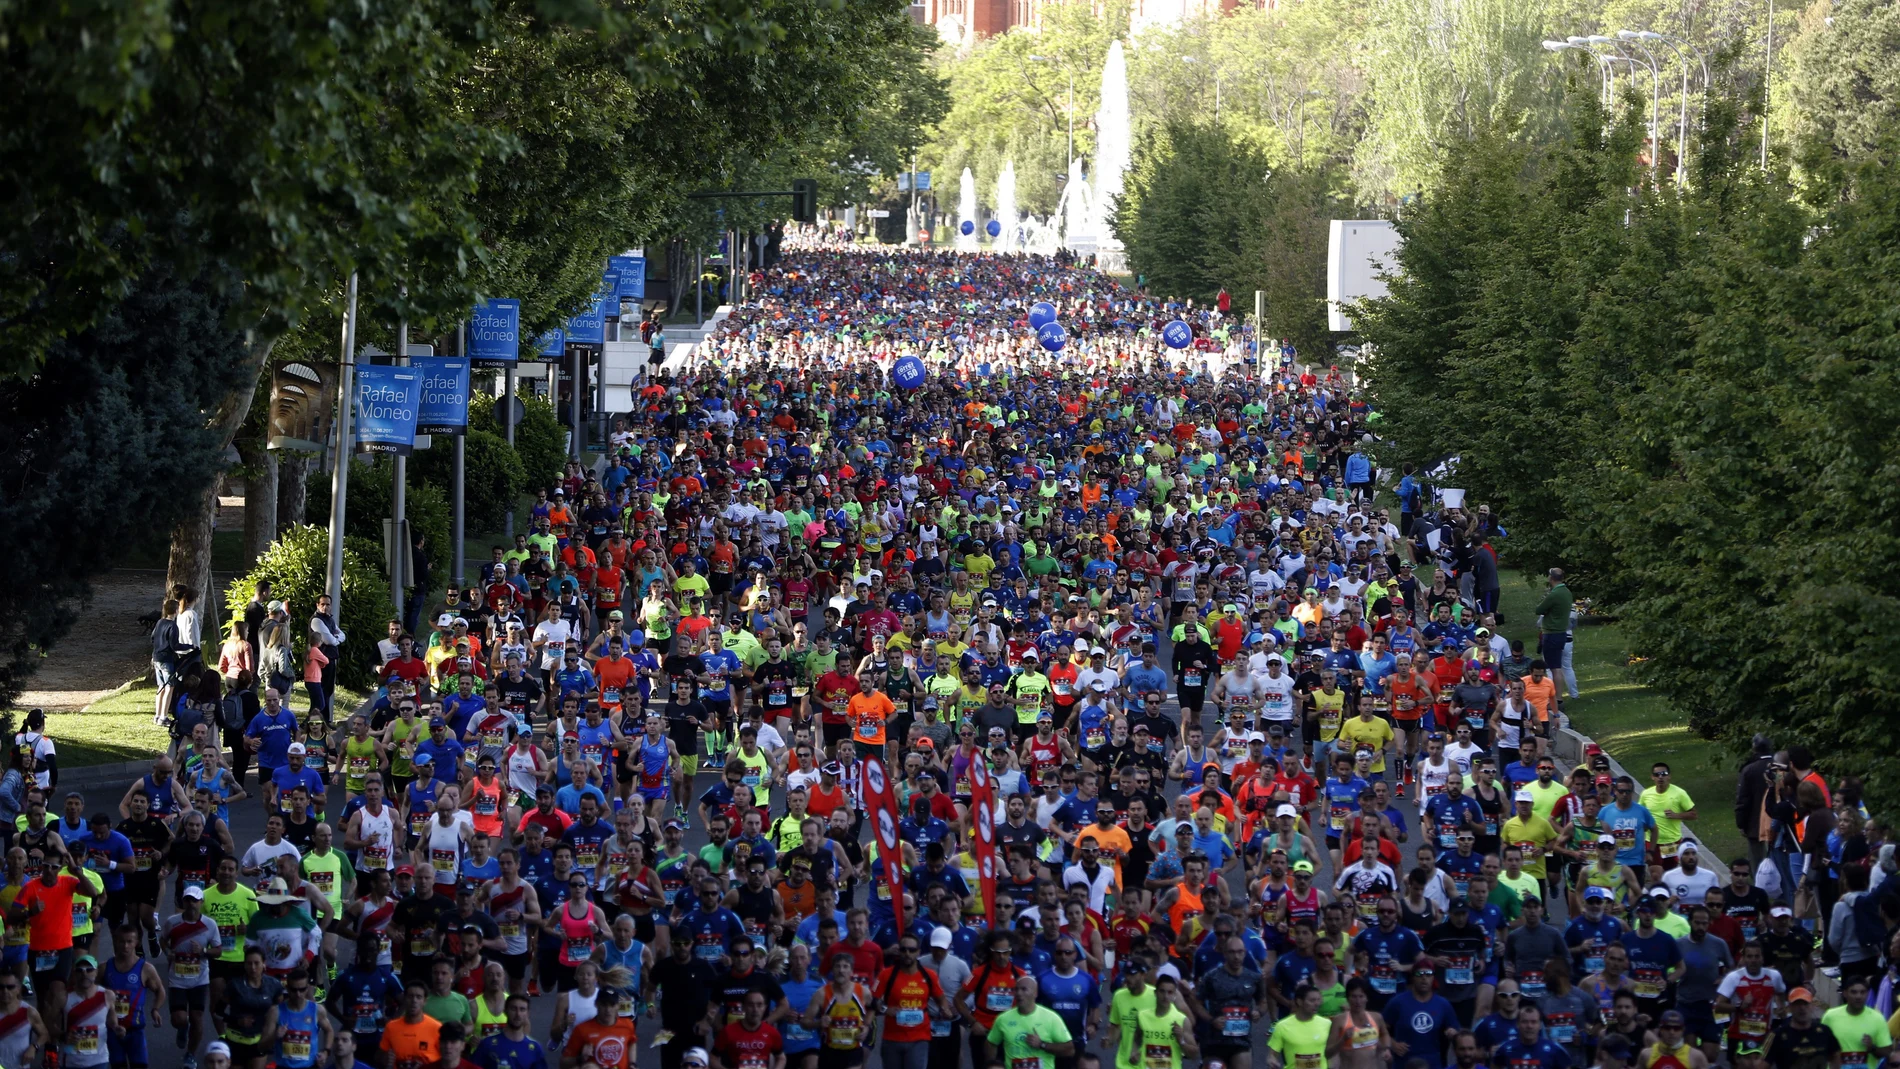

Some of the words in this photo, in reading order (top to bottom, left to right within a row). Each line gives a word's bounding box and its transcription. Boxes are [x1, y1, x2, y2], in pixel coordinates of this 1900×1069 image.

[471, 314, 510, 328] Rafael
[471, 328, 514, 342] Moneo
[1173, 331, 1187, 343] 3.15
[902, 368, 919, 381] 1.50
[360, 385, 409, 404] Rafael
[360, 402, 412, 421] Moneo
[736, 1040, 766, 1050] FALCO
